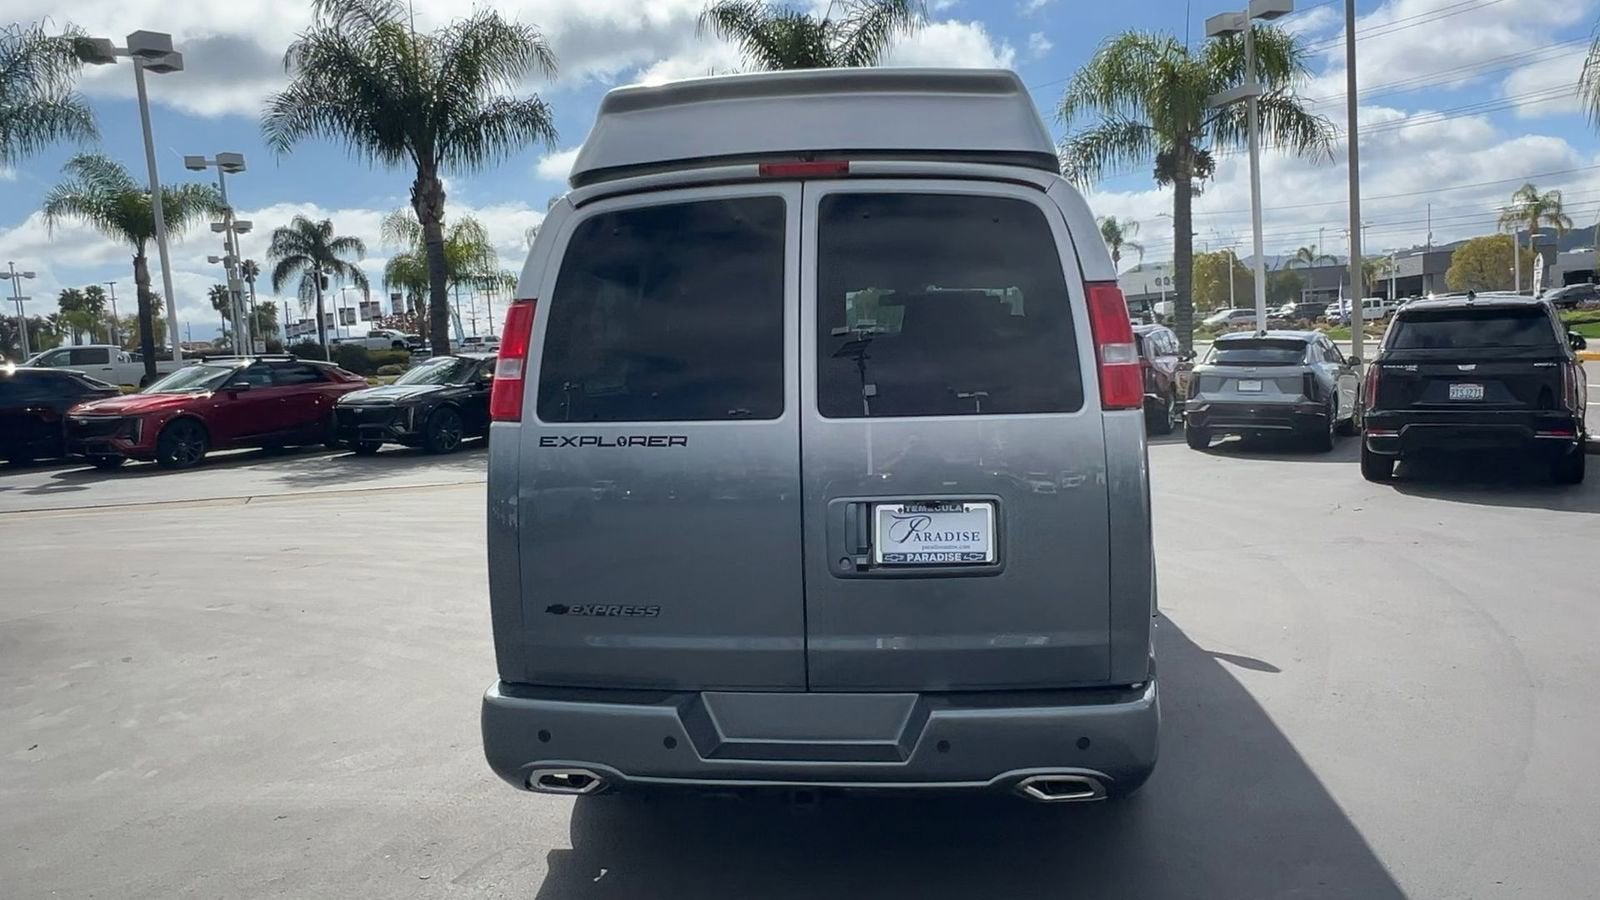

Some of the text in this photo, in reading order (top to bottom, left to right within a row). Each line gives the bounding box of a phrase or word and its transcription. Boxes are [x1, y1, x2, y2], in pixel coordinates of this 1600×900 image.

[539, 436, 688, 447] EXPLORER
[889, 514, 981, 543] PARADISE
[907, 552, 962, 562] PARADISE
[567, 604, 661, 617] EXPRESS
